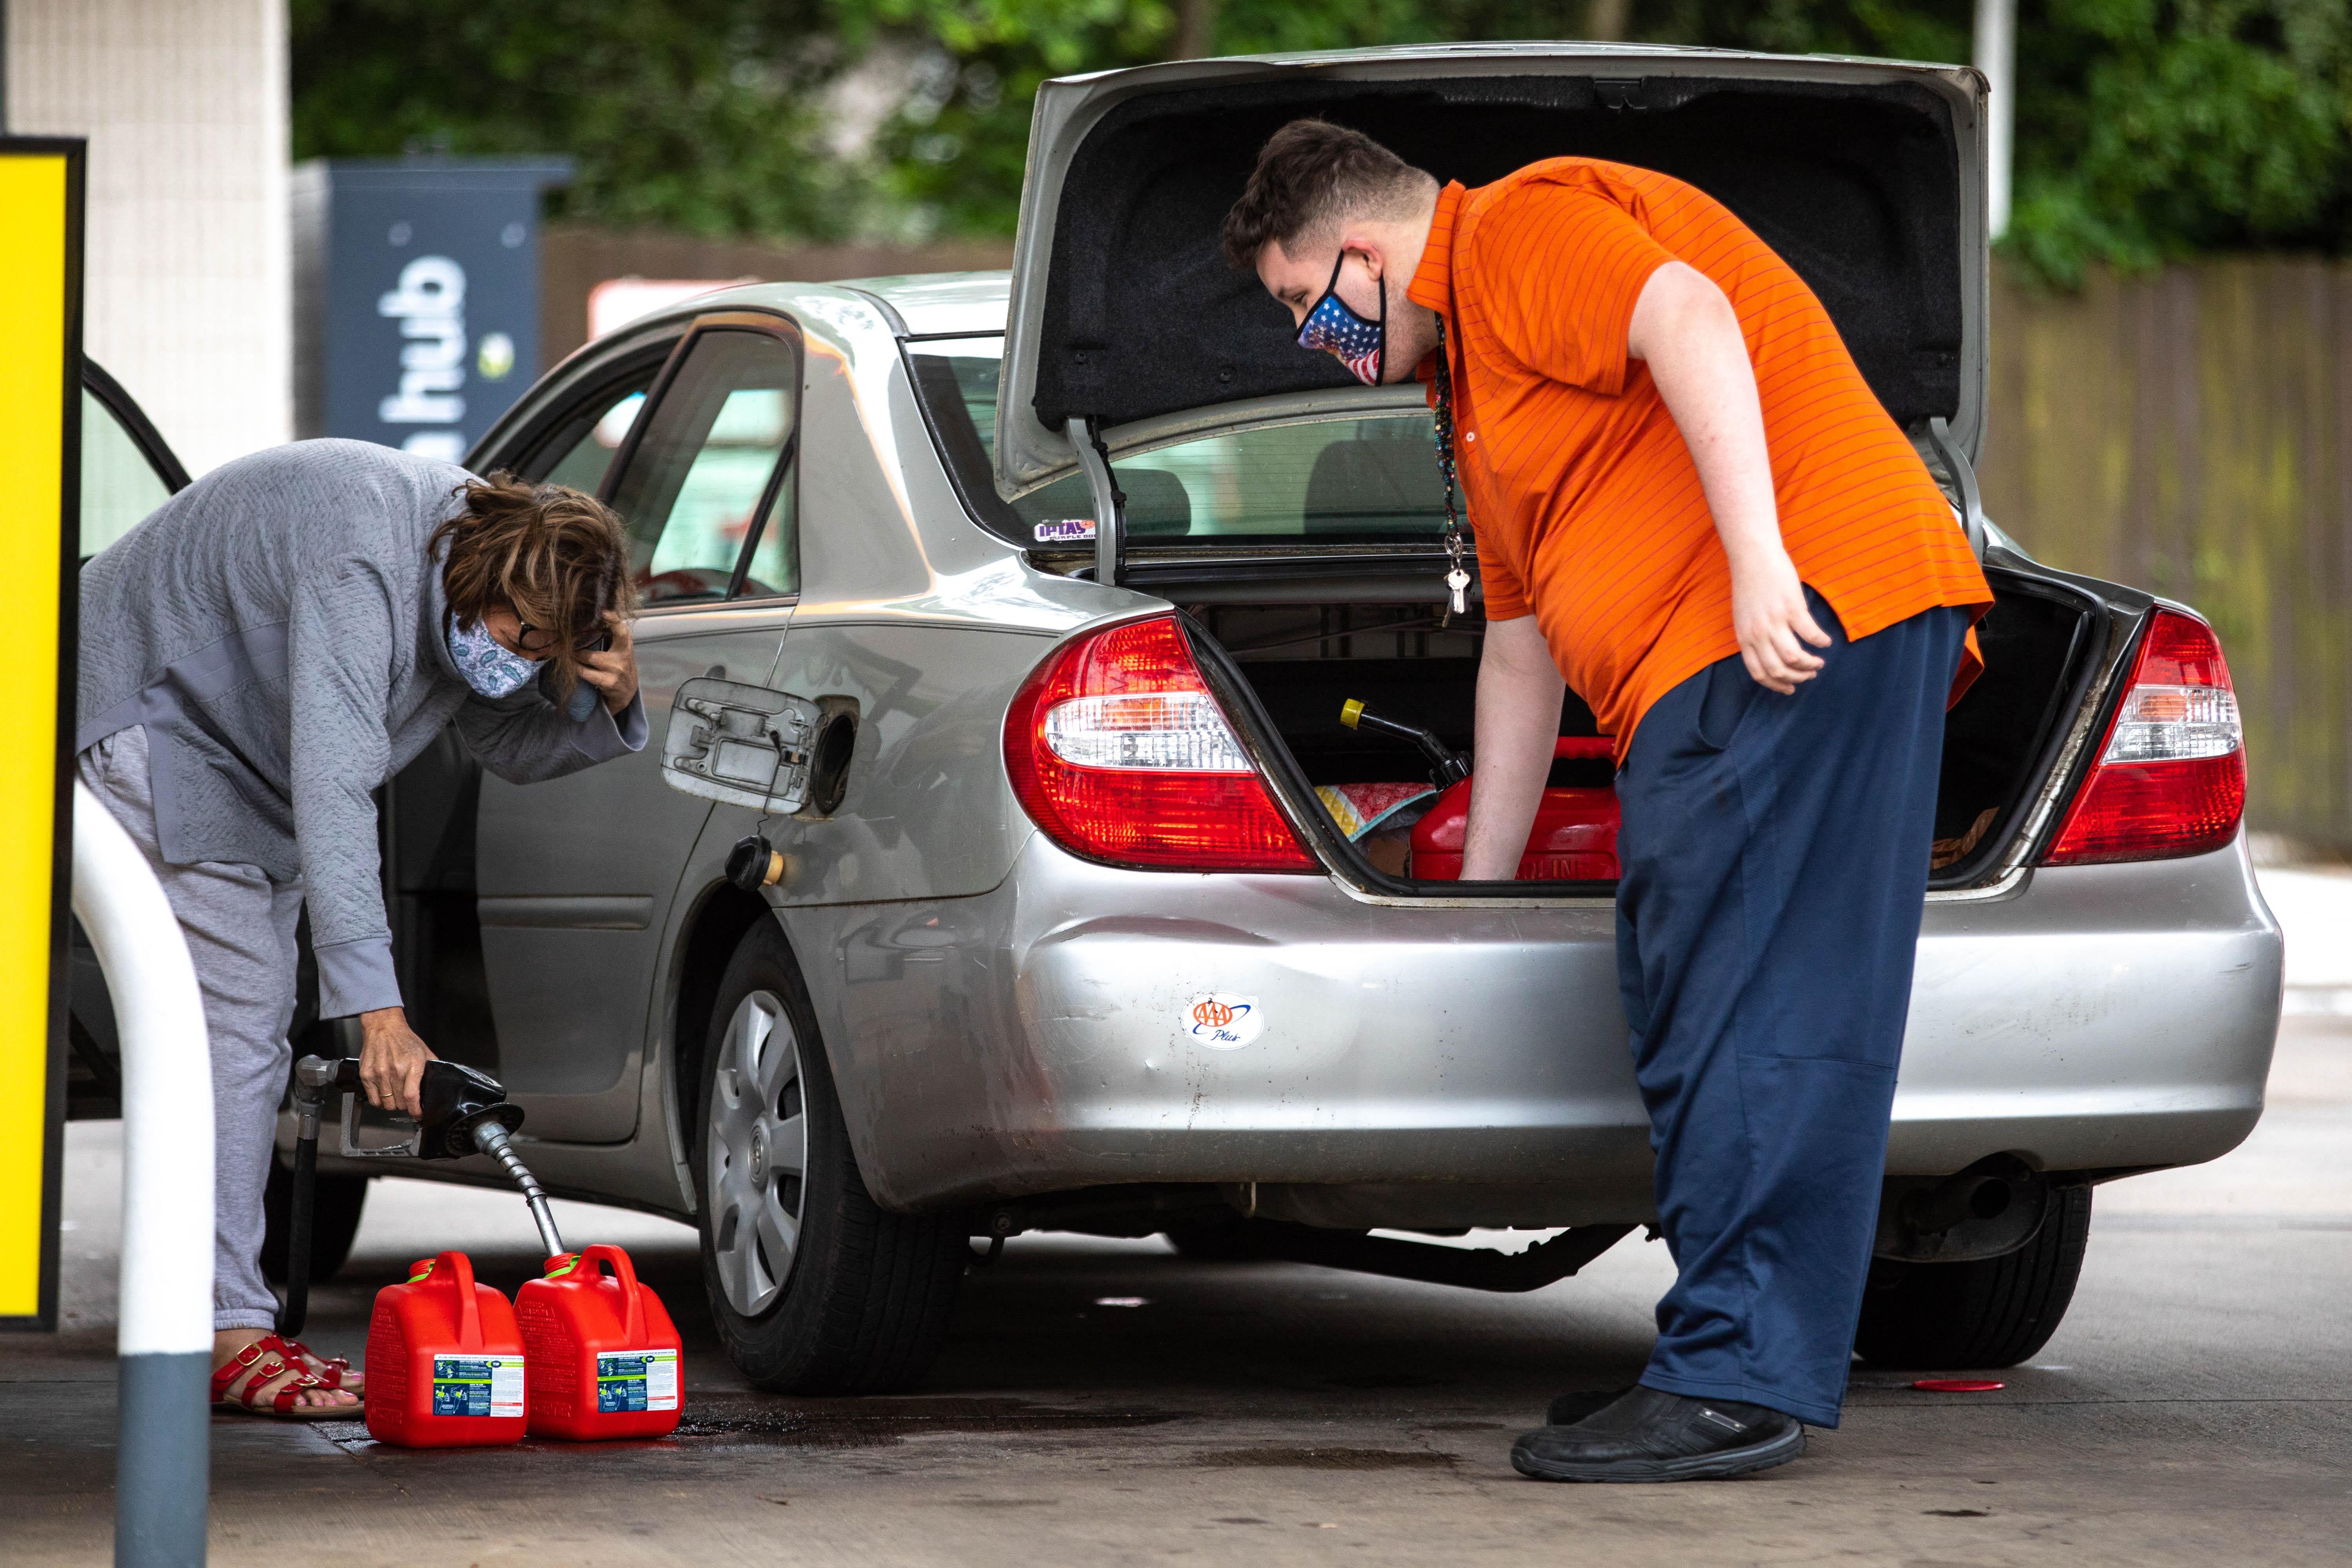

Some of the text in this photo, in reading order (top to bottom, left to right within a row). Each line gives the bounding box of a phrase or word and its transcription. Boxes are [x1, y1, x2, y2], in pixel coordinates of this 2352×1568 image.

[379, 255, 466, 423] hub
[1197, 1002, 1230, 1026] AAA
[1210, 1029, 1240, 1042] Plus
